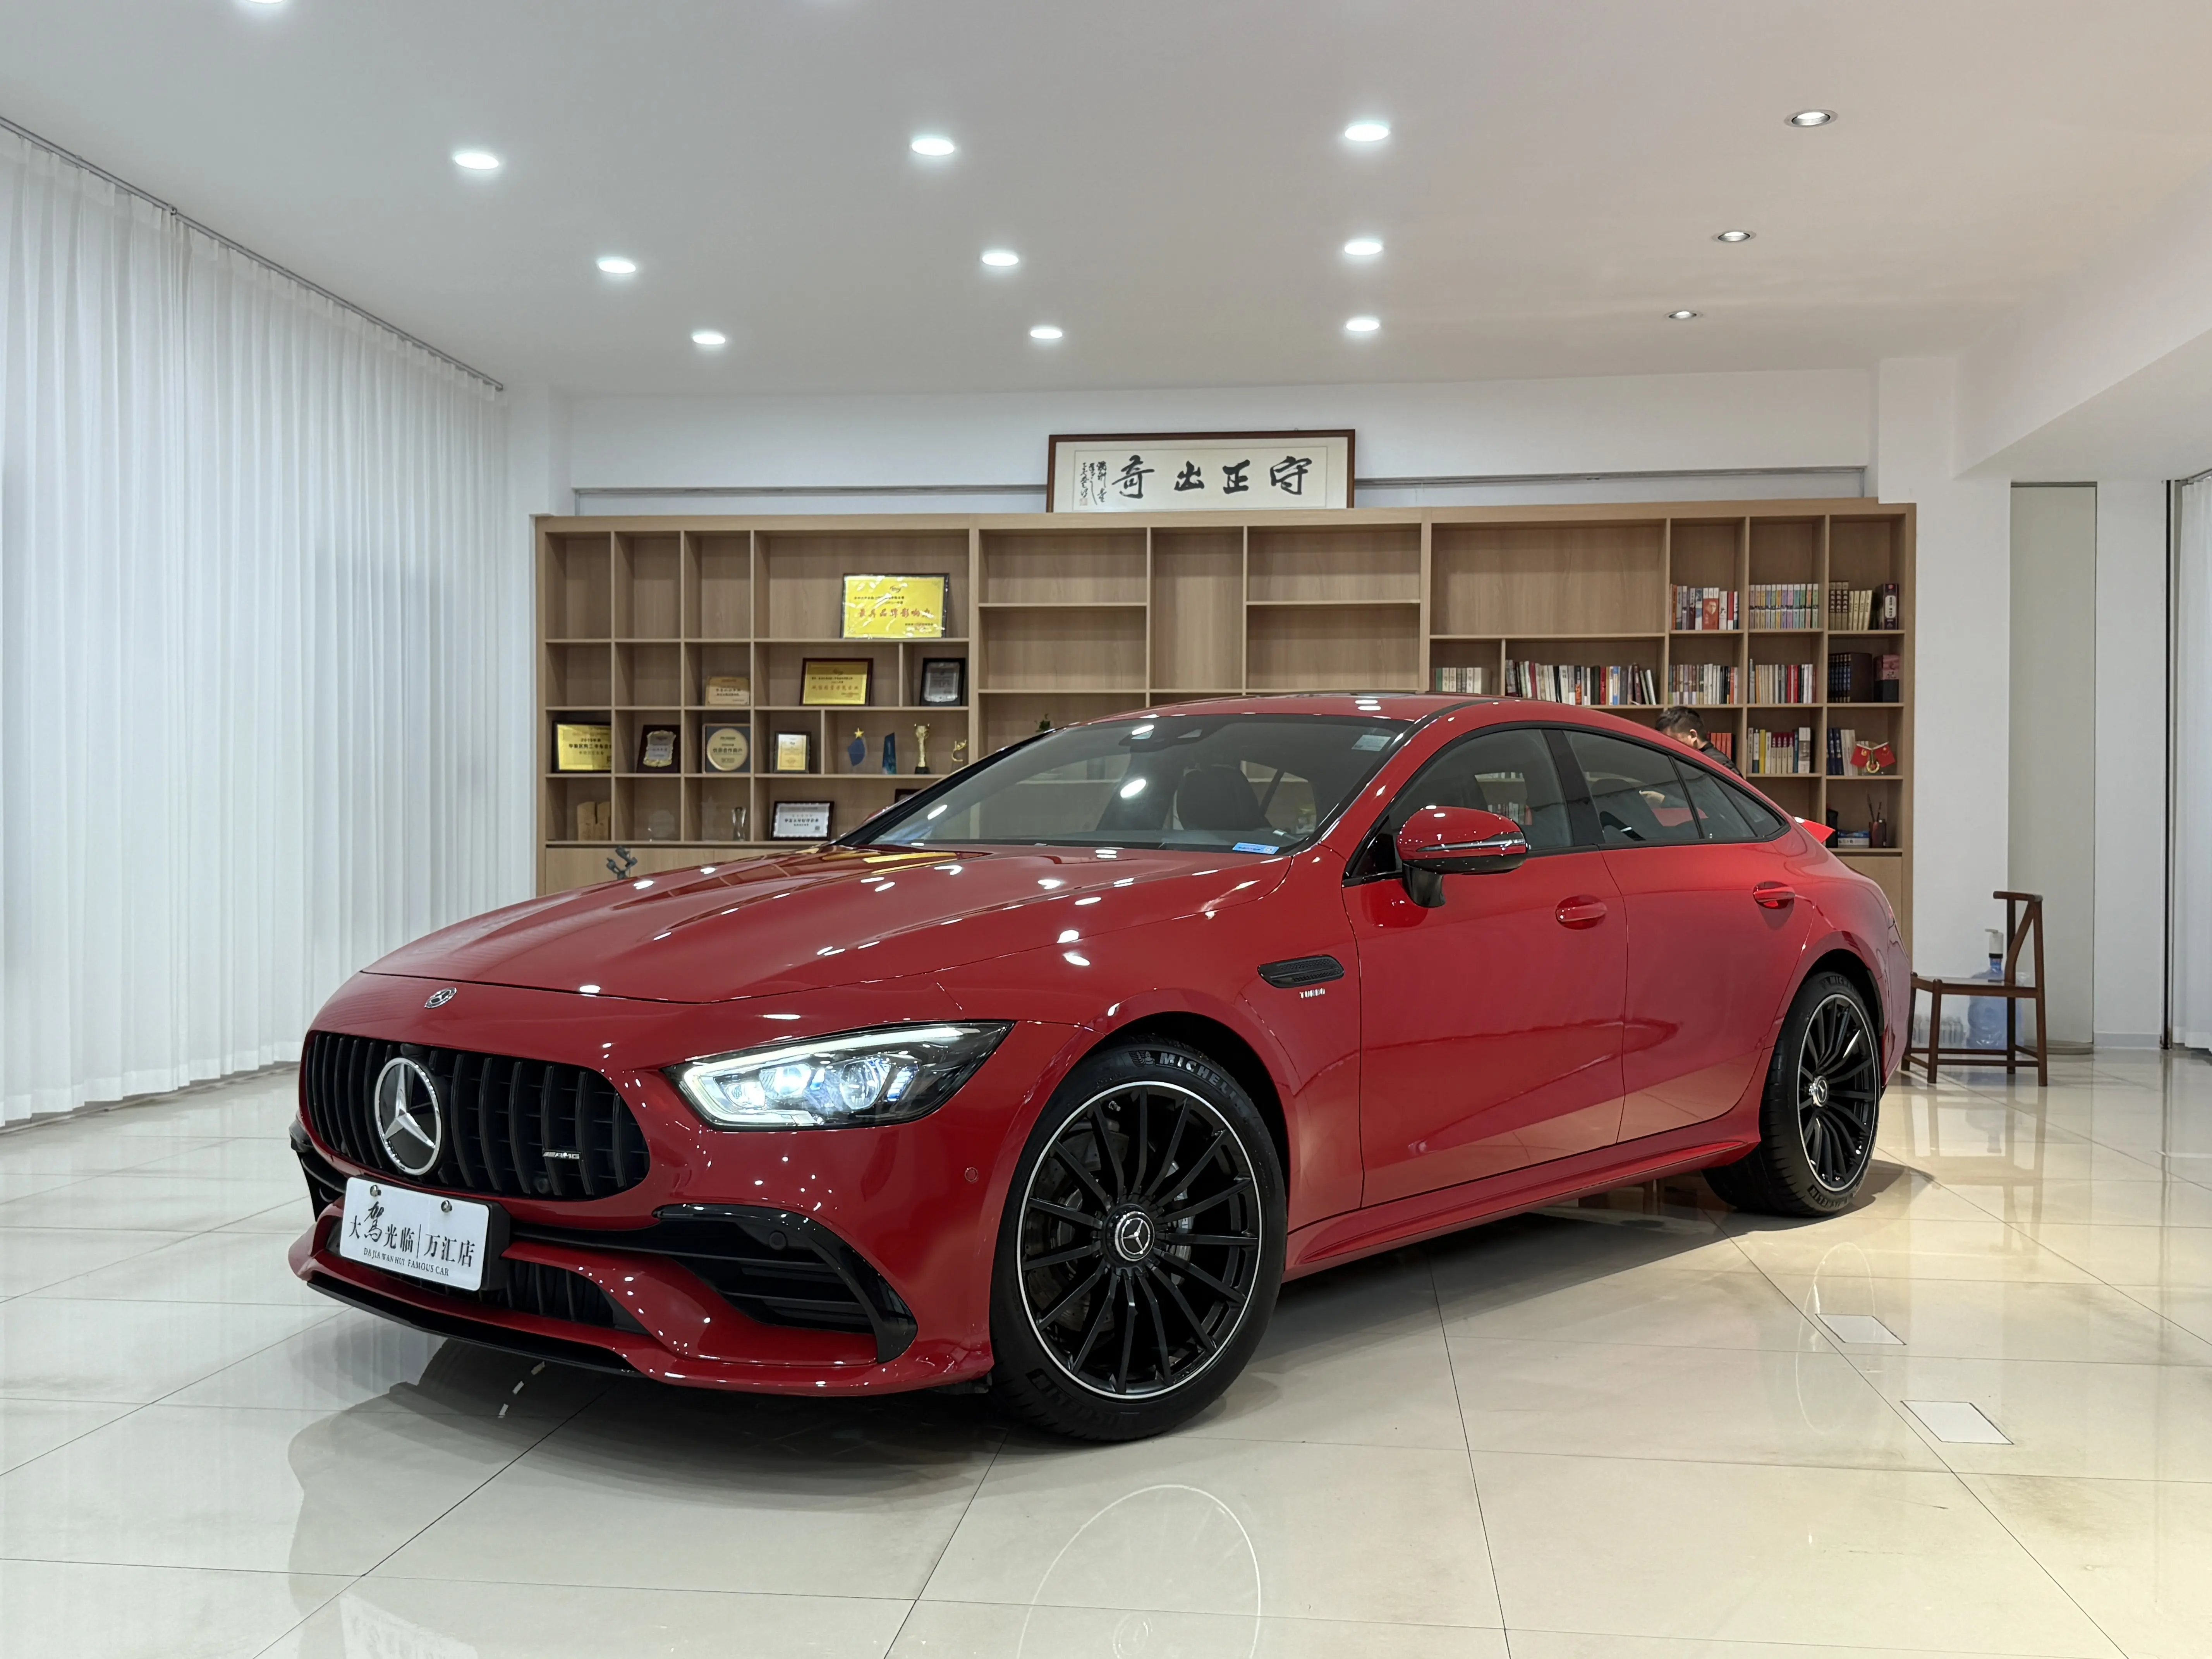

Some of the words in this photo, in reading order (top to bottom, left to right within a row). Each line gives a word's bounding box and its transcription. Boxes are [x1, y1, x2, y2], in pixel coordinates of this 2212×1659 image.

[1299, 988, 1325, 998] TURBO
[349, 1201, 415, 1253] 大驾光临
[424, 1235, 475, 1267] 万汇店
[364, 1247, 371, 1256] DA
[372, 1250, 380, 1259] JIA
[382, 1253, 393, 1262] WAN
[395, 1257, 405, 1266] HUI
[408, 1259, 434, 1273] FAMOUS
[435, 1266, 449, 1276] CAR
